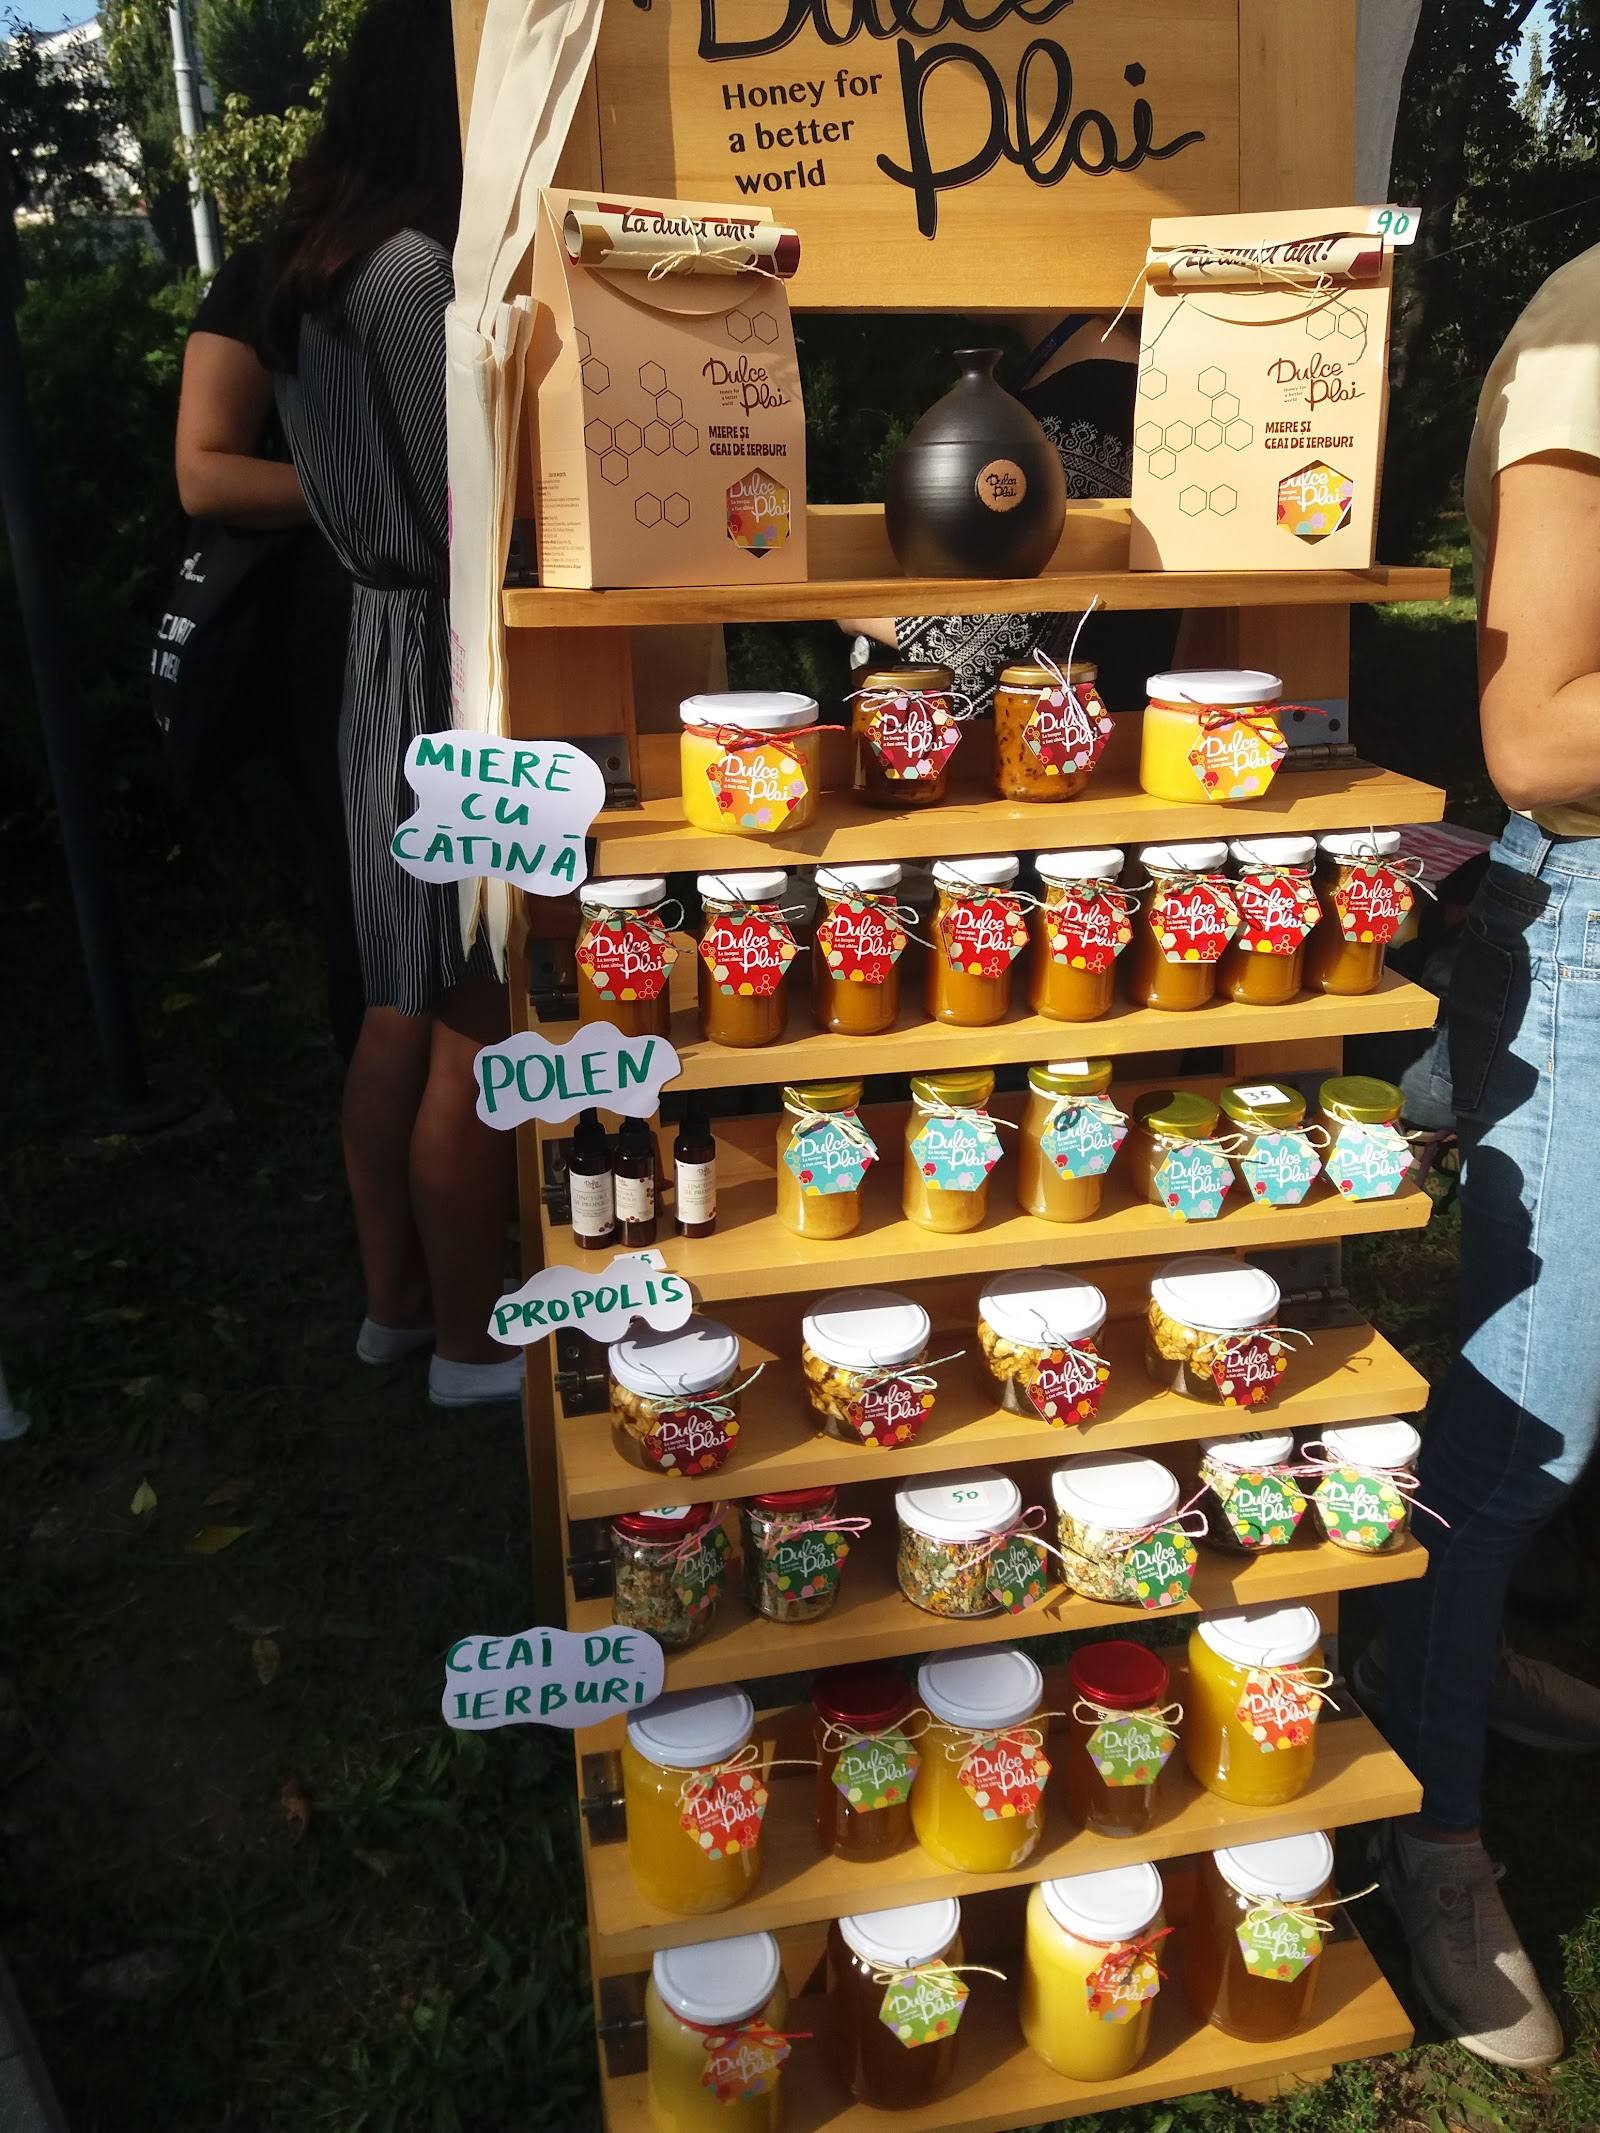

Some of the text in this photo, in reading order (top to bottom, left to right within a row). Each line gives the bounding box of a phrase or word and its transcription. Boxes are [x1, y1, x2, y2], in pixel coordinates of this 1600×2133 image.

[721, 68, 883, 112] Honey for
[728, 119, 856, 154] a better
[876, 37, 1206, 239] Plai
[734, 159, 827, 195] world
[1377, 209, 1410, 235] 90
[703, 355, 768, 385] Dulce
[1267, 352, 1343, 384] Dulce
[739, 383, 791, 417] Plai
[1305, 378, 1365, 412] Plai
[708, 426, 739, 439] MIERE
[1265, 421, 1299, 434] MIERE
[710, 443, 787, 457] CEAI DE IERBURI
[1265, 436, 1354, 449] CEAI DE IERBURI
[876, 710, 933, 735] Dulce
[904, 732, 950, 758] Plai
[1200, 729, 1259, 758] Dulce
[415, 737, 576, 792] MIERE
[719, 754, 780, 780] Dulce
[1227, 749, 1276, 777] Plai
[748, 778, 793, 805] Plai
[461, 792, 530, 826] CU
[1241, 887, 1295, 909] Dulce
[1346, 878, 1393, 900] Dulce
[952, 907, 1004, 931] Dulce
[1059, 900, 1111, 926] Dulce
[1157, 895, 1216, 919] Dulce
[1262, 906, 1306, 932] Plai
[1366, 898, 1403, 922] Plai
[829, 915, 884, 937] Dulce
[1081, 923, 1124, 949] Plai
[1186, 916, 1233, 941] Plai
[588, 932, 650, 957] Dulce
[711, 927, 769, 953] Dulce
[854, 935, 898, 961] Plai
[974, 929, 1016, 955] Plai
[620, 953, 669, 980] Plai
[739, 947, 788, 975] Plai
[482, 1039, 656, 1114] POLEN
[1243, 1090, 1272, 1101] 35
[794, 1131, 849, 1158] Dulce
[922, 1128, 977, 1150] Dulce
[1078, 1135, 1118, 1158] Plai
[823, 1150, 866, 1175] Plai
[948, 1147, 989, 1171] Plai
[1165, 1156, 1213, 1180] Dulce
[1254, 1147, 1302, 1168] Dulce
[1338, 1143, 1389, 1168] Dulce
[1274, 1164, 1314, 1189] Plai
[1359, 1160, 1406, 1183] Plai
[1188, 1176, 1225, 1200] Plai
[493, 1276, 684, 1336] PROPOLIS
[1226, 1345, 1269, 1369] Dulce
[1243, 1362, 1279, 1387] Plai
[859, 1384, 912, 1408] Dulce
[1064, 1380, 1102, 1404] Plai
[885, 1402, 927, 1426] Plai
[655, 1415, 714, 1442] Dulce
[686, 1431, 732, 1457] Plai
[952, 1490, 979, 1503] 50
[1230, 1485, 1284, 1508] Dulce
[1325, 1483, 1380, 1507] Dulce
[1259, 1503, 1298, 1527] Plai
[1350, 1503, 1394, 1524] Plai
[772, 1539, 825, 1566] Dulce
[991, 1545, 1029, 1579] Dulce
[1131, 1541, 1176, 1570] Dulce
[799, 1555, 843, 1578] Plai
[1015, 1556, 1045, 1588] Plai
[1155, 1558, 1193, 1585] Plai
[584, 1635, 638, 1667] DE
[1097, 1727, 1151, 1748] Dulce
[841, 1749, 895, 1776] Dulce
[967, 1750, 1023, 1778] Dulce
[1125, 1744, 1167, 1767] Plai
[871, 1764, 914, 1790] Plai
[999, 1770, 1039, 1797] Plai
[688, 1786, 744, 1820] Dulce
[720, 1801, 762, 1832] Plai
[1247, 1919, 1300, 1942] Dulce
[1270, 1940, 1313, 1962] Plai
[890, 1985, 941, 2015] Dulce
